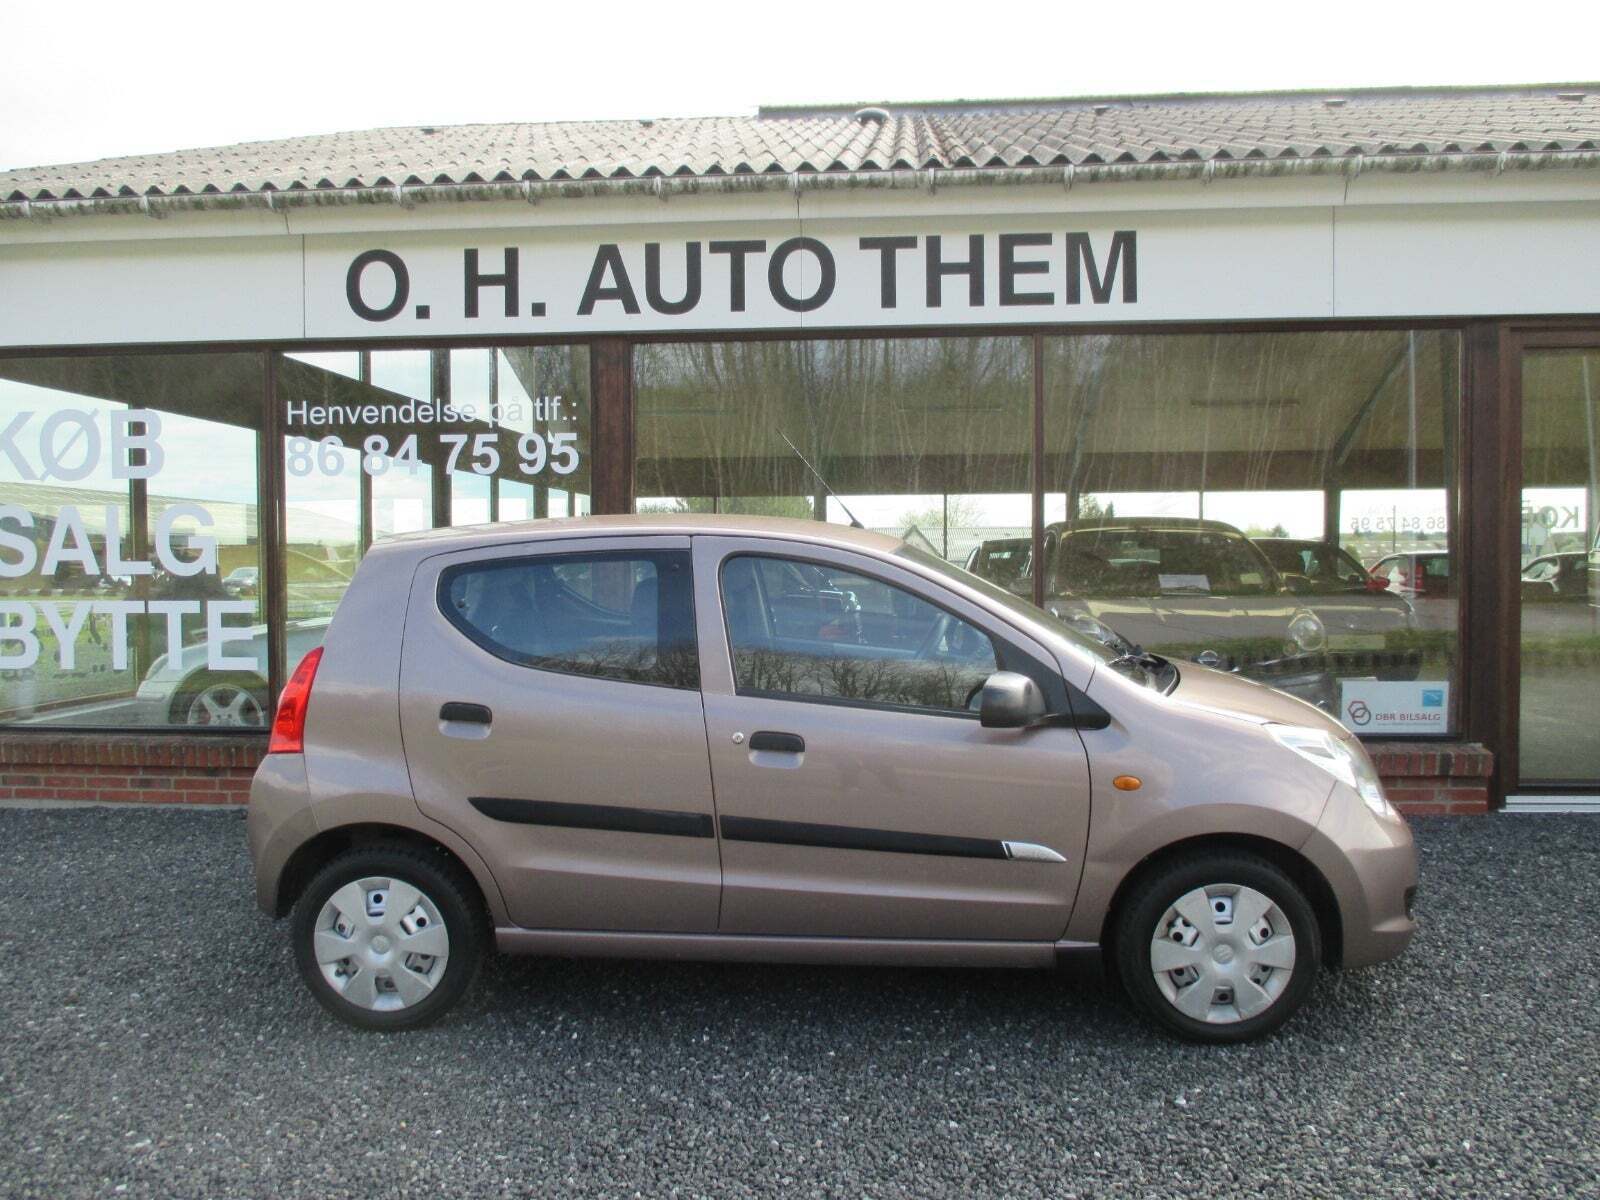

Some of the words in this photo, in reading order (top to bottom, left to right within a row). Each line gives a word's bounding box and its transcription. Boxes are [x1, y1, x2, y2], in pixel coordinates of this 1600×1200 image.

[346, 248, 430, 322] O.
[463, 247, 546, 318] H.
[577, 236, 836, 316] AUTO
[859, 230, 1138, 309] THEM
[287, 398, 476, 425] Henvendelse
[489, 395, 523, 428] på
[534, 396, 577, 422] tlf.:
[287, 435, 344, 477] 86
[363, 434, 418, 476] 84
[440, 433, 500, 475] 75
[517, 432, 579, 475] 95
[0, 503, 217, 577] SALG
[0, 600, 259, 671] BYTTE
[1399, 711, 1441, 721] BILSALG
